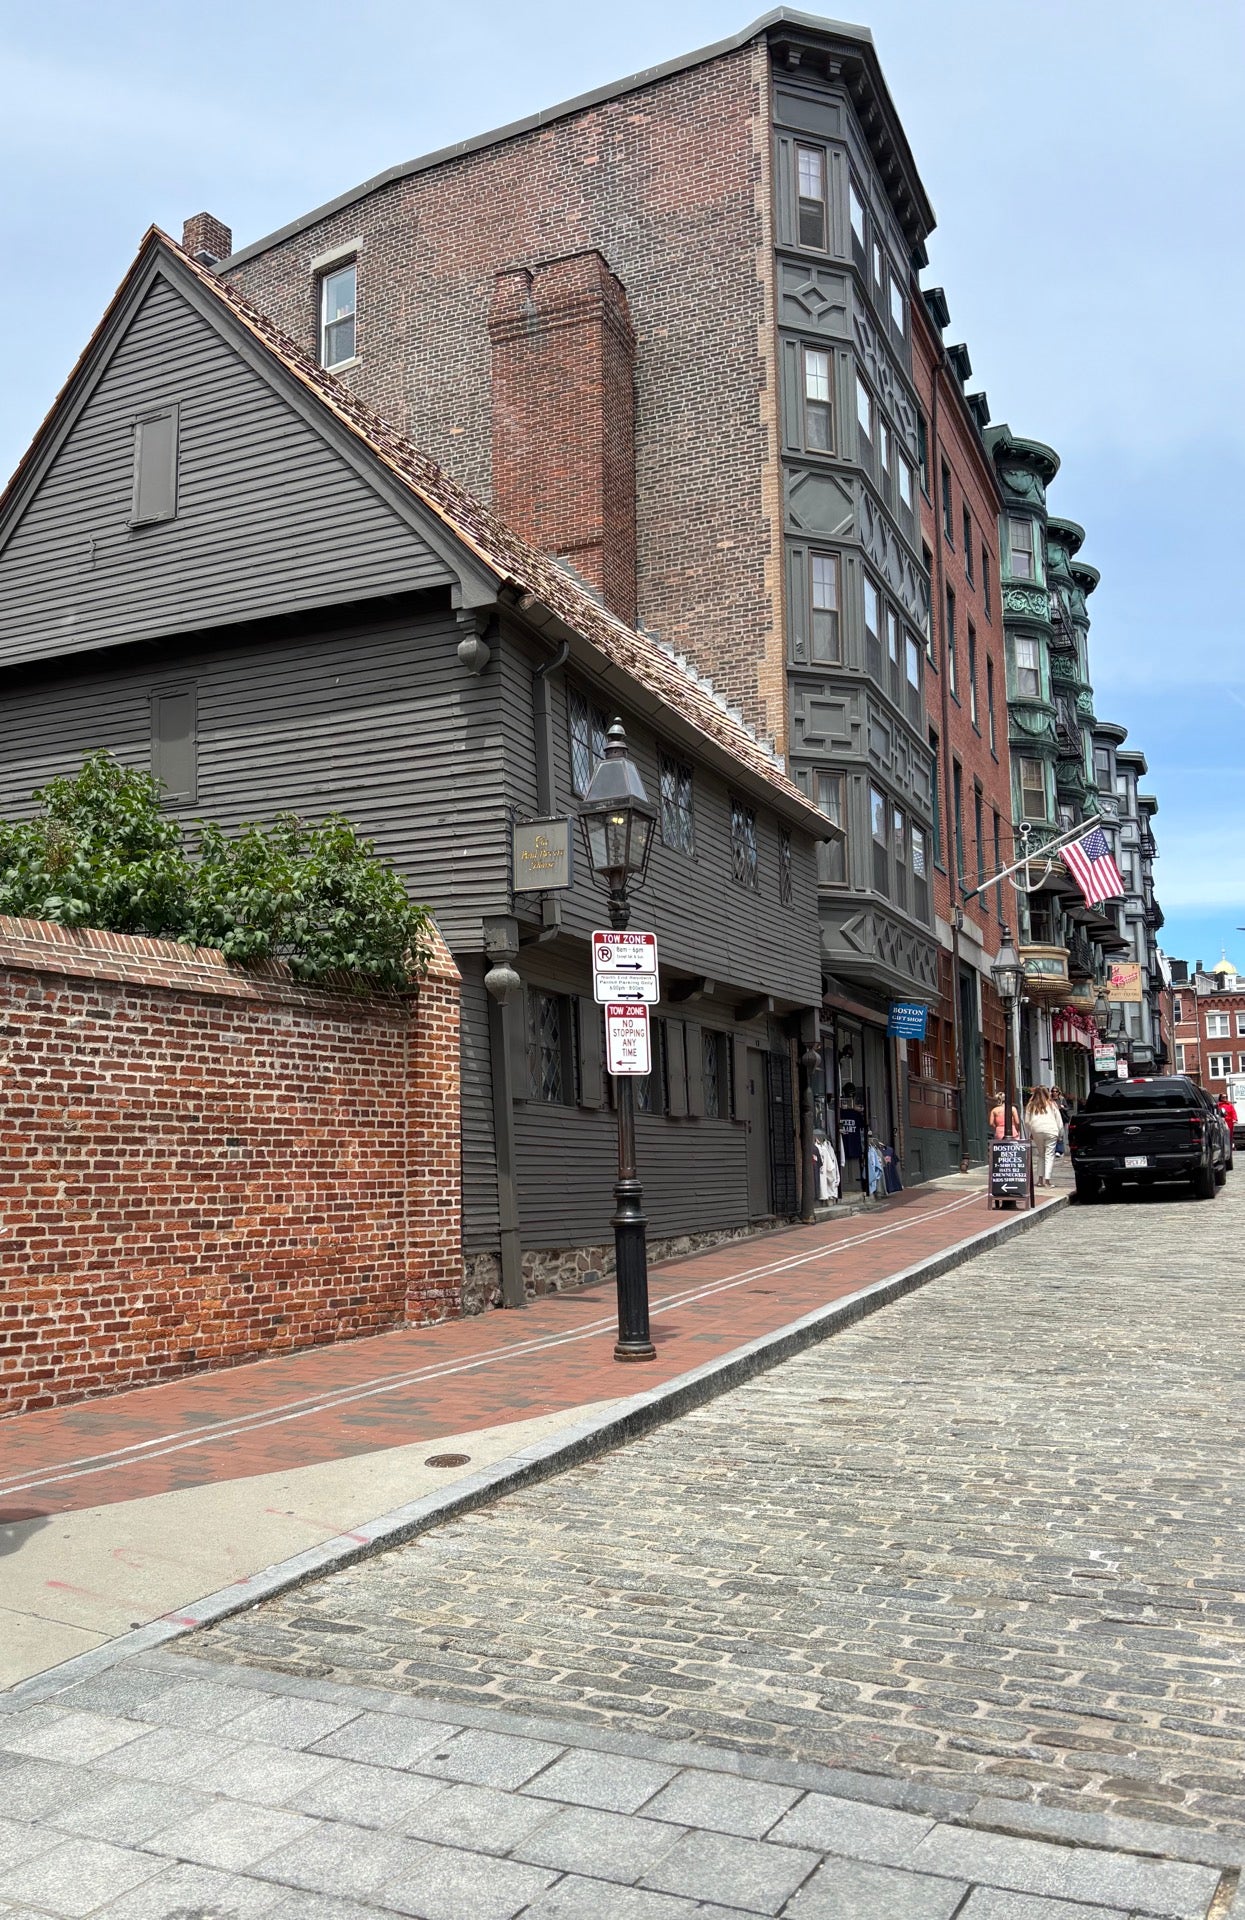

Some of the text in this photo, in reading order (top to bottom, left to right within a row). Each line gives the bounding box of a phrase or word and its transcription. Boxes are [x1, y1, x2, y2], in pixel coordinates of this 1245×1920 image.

[602, 934, 647, 944] TOW ZONE
[609, 1006, 645, 1016] TOW ZONE
[893, 1007, 924, 1016] BOSTON
[622, 1019, 634, 1028] NO
[613, 1028, 645, 1038] STOPPING
[622, 1038, 636, 1047] ANY
[622, 1048, 637, 1057] TIME
